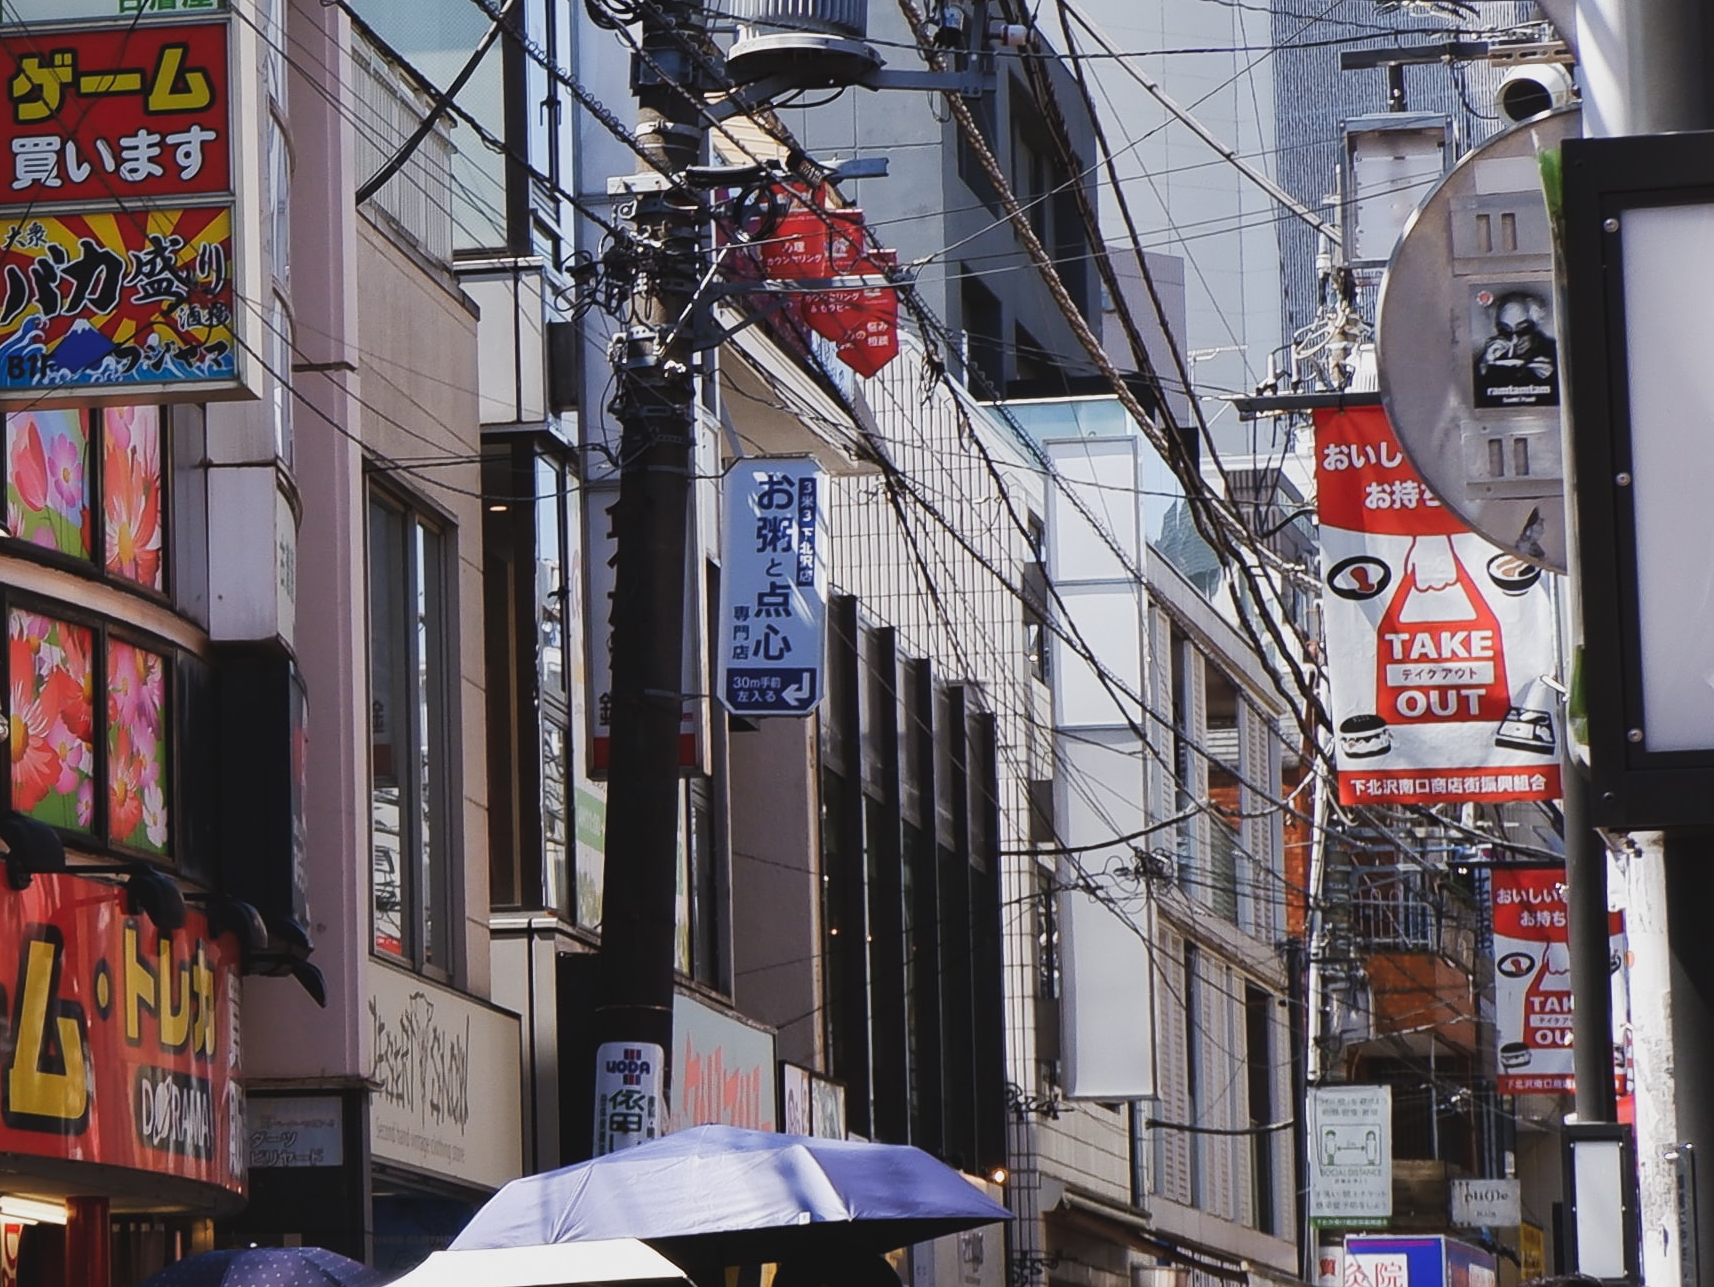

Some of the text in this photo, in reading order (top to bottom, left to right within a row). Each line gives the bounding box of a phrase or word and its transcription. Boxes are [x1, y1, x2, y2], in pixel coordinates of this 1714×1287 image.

[9, 45, 214, 122] ゲーム
[11, 125, 218, 190] 買います
[2, 221, 49, 249] 大衆
[112, 340, 230, 376] フジヤマ
[752, 473, 796, 661] お粥と点心
[731, 605, 751, 661] 専門店
[1384, 630, 1495, 660] TAKE
[733, 676, 782, 690] 30m手前
[1402, 666, 1478, 681] テイクアウト
[736, 690, 777, 703] 左入る
[1396, 688, 1487, 718] OUT
[1350, 774, 1547, 796] 下北沢南口商店街振興組合
[249, 1130, 298, 1147] ダーツ
[249, 1149, 324, 1165] ビリヤード
